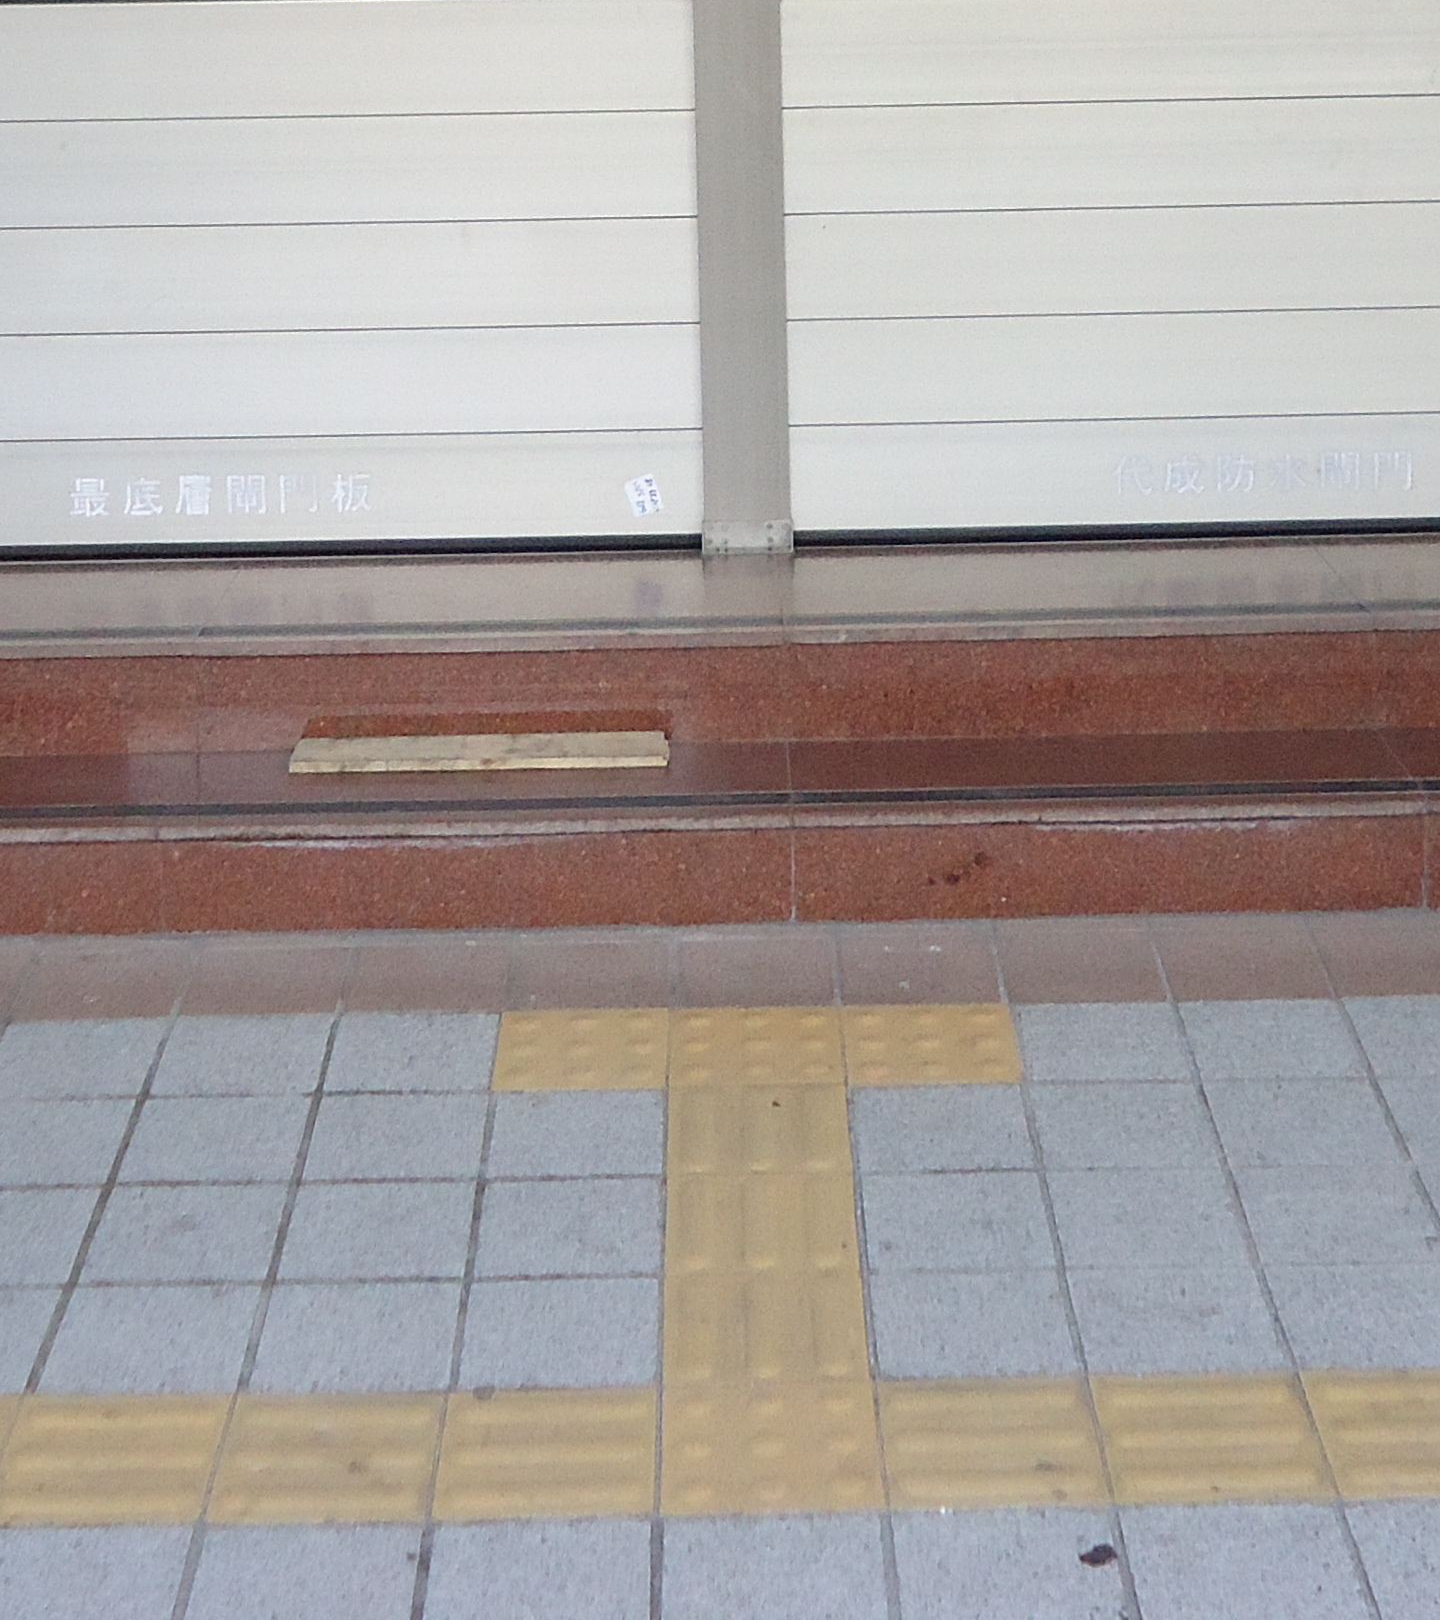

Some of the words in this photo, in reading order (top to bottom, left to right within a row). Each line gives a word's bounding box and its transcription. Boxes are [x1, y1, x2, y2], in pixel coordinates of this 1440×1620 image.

[69, 472, 372, 519] 最底層閘門板
